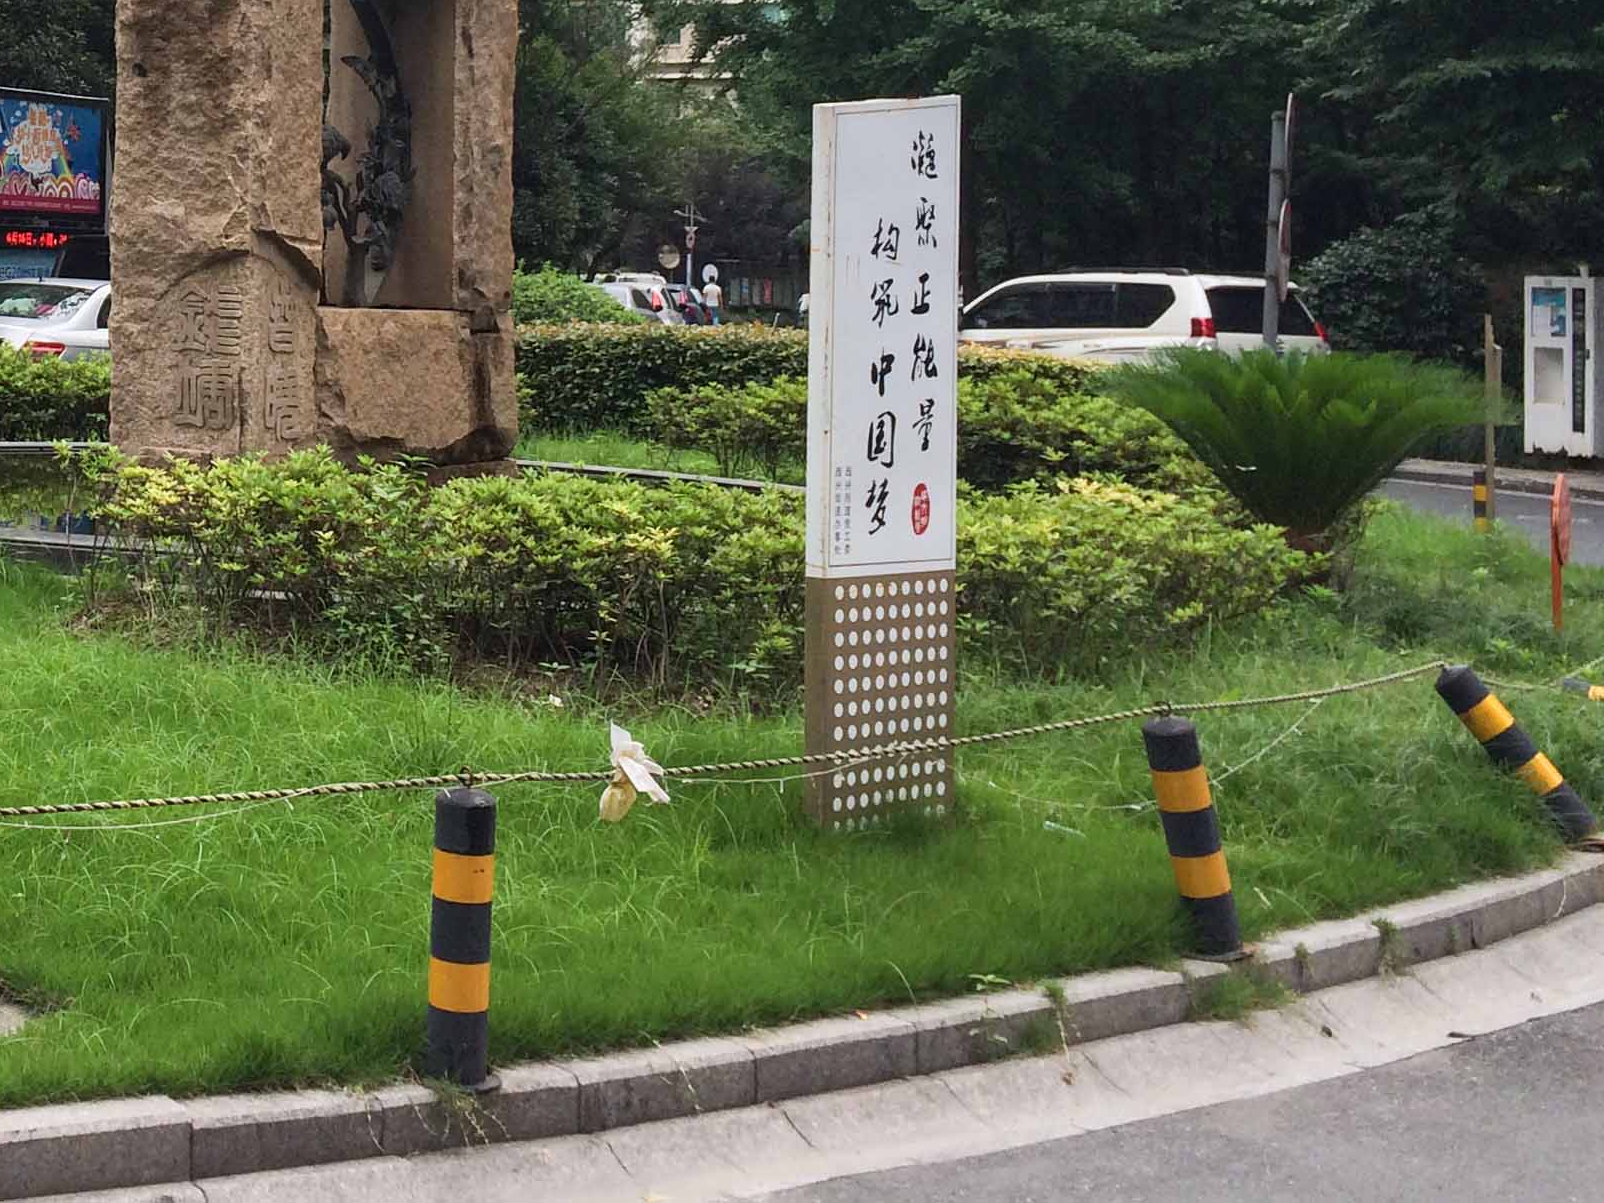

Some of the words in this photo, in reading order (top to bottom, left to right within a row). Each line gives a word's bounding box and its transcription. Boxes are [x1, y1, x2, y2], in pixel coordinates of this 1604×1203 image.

[865, 216, 900, 536] 构筑中国梦
[911, 129, 939, 453] 凝聚正能量
